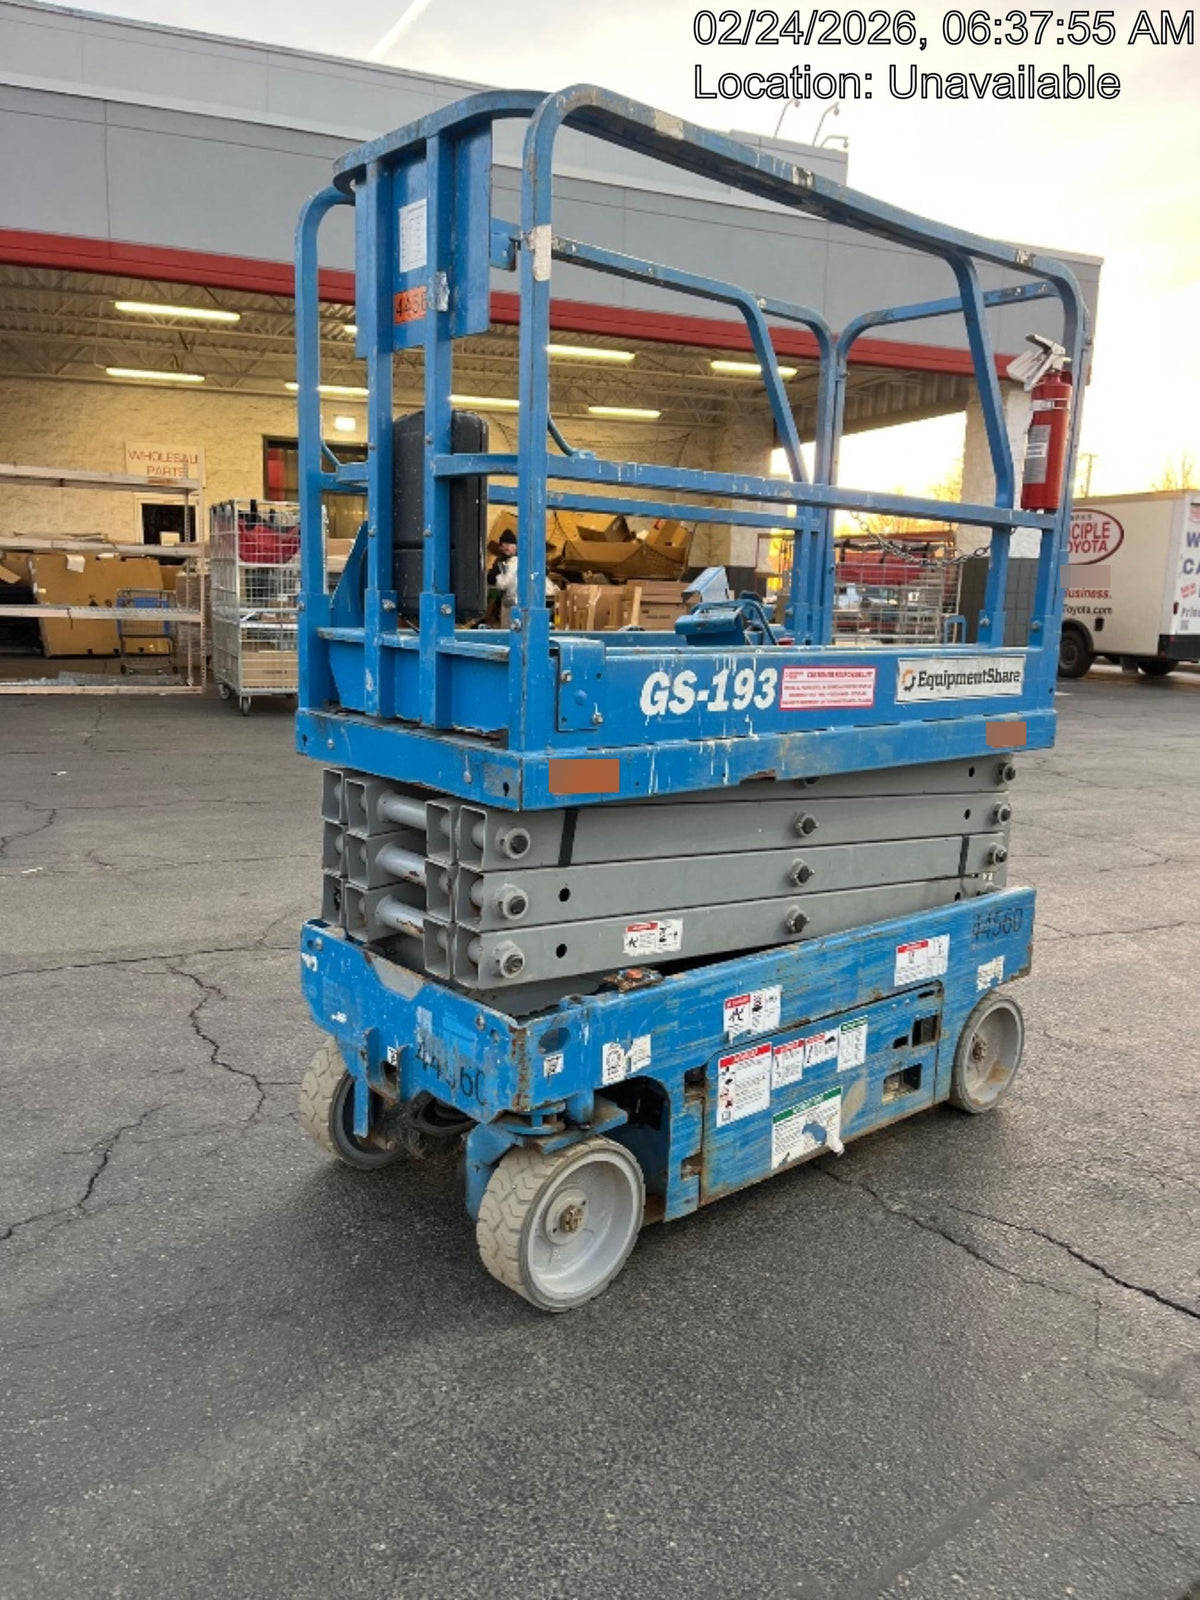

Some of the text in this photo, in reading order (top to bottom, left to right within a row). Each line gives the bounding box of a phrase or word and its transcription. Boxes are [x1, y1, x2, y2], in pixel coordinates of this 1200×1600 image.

[1069, 522, 1111, 540] CIPLE
[917, 668, 1021, 690] EquipmentShare
[639, 667, 778, 716] GS-193
